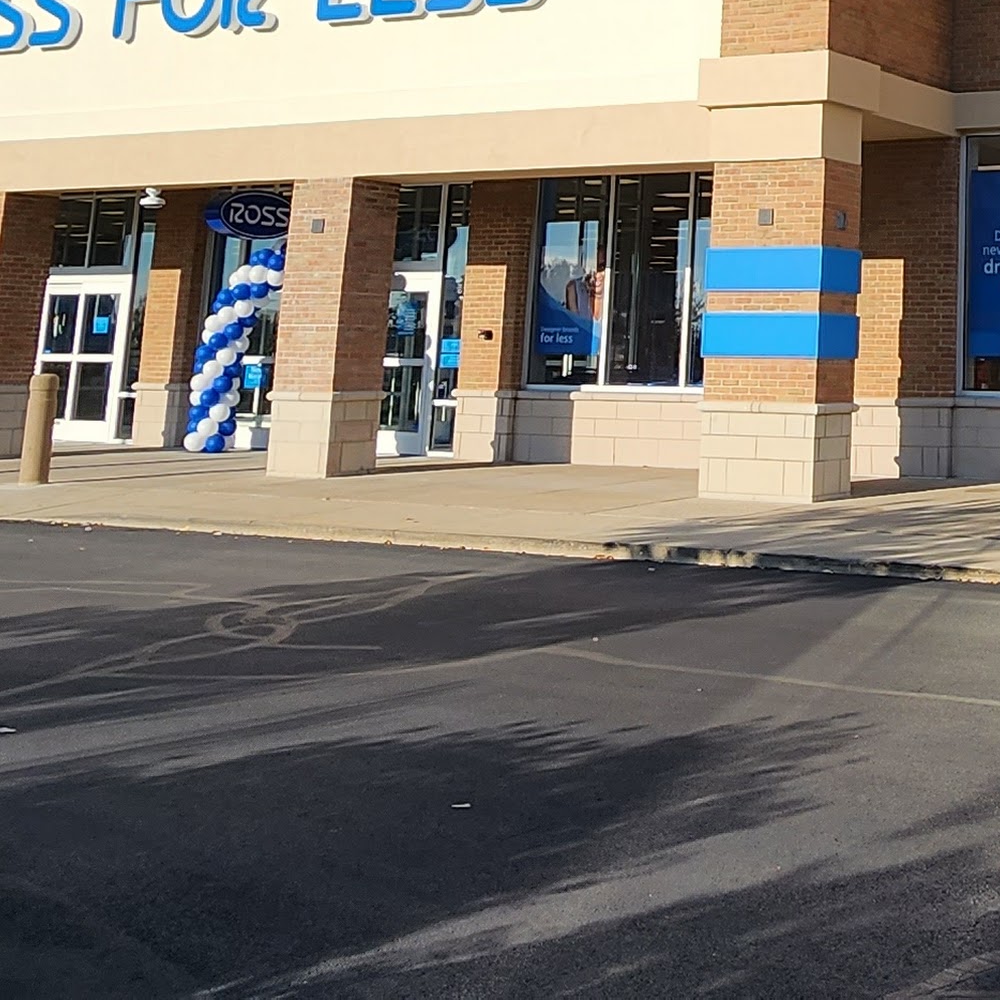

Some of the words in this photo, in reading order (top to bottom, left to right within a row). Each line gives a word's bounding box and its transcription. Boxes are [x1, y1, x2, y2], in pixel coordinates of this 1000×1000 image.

[229, 202, 290, 227] ROSS
[540, 333, 554, 343] for
[556, 333, 573, 344] less
